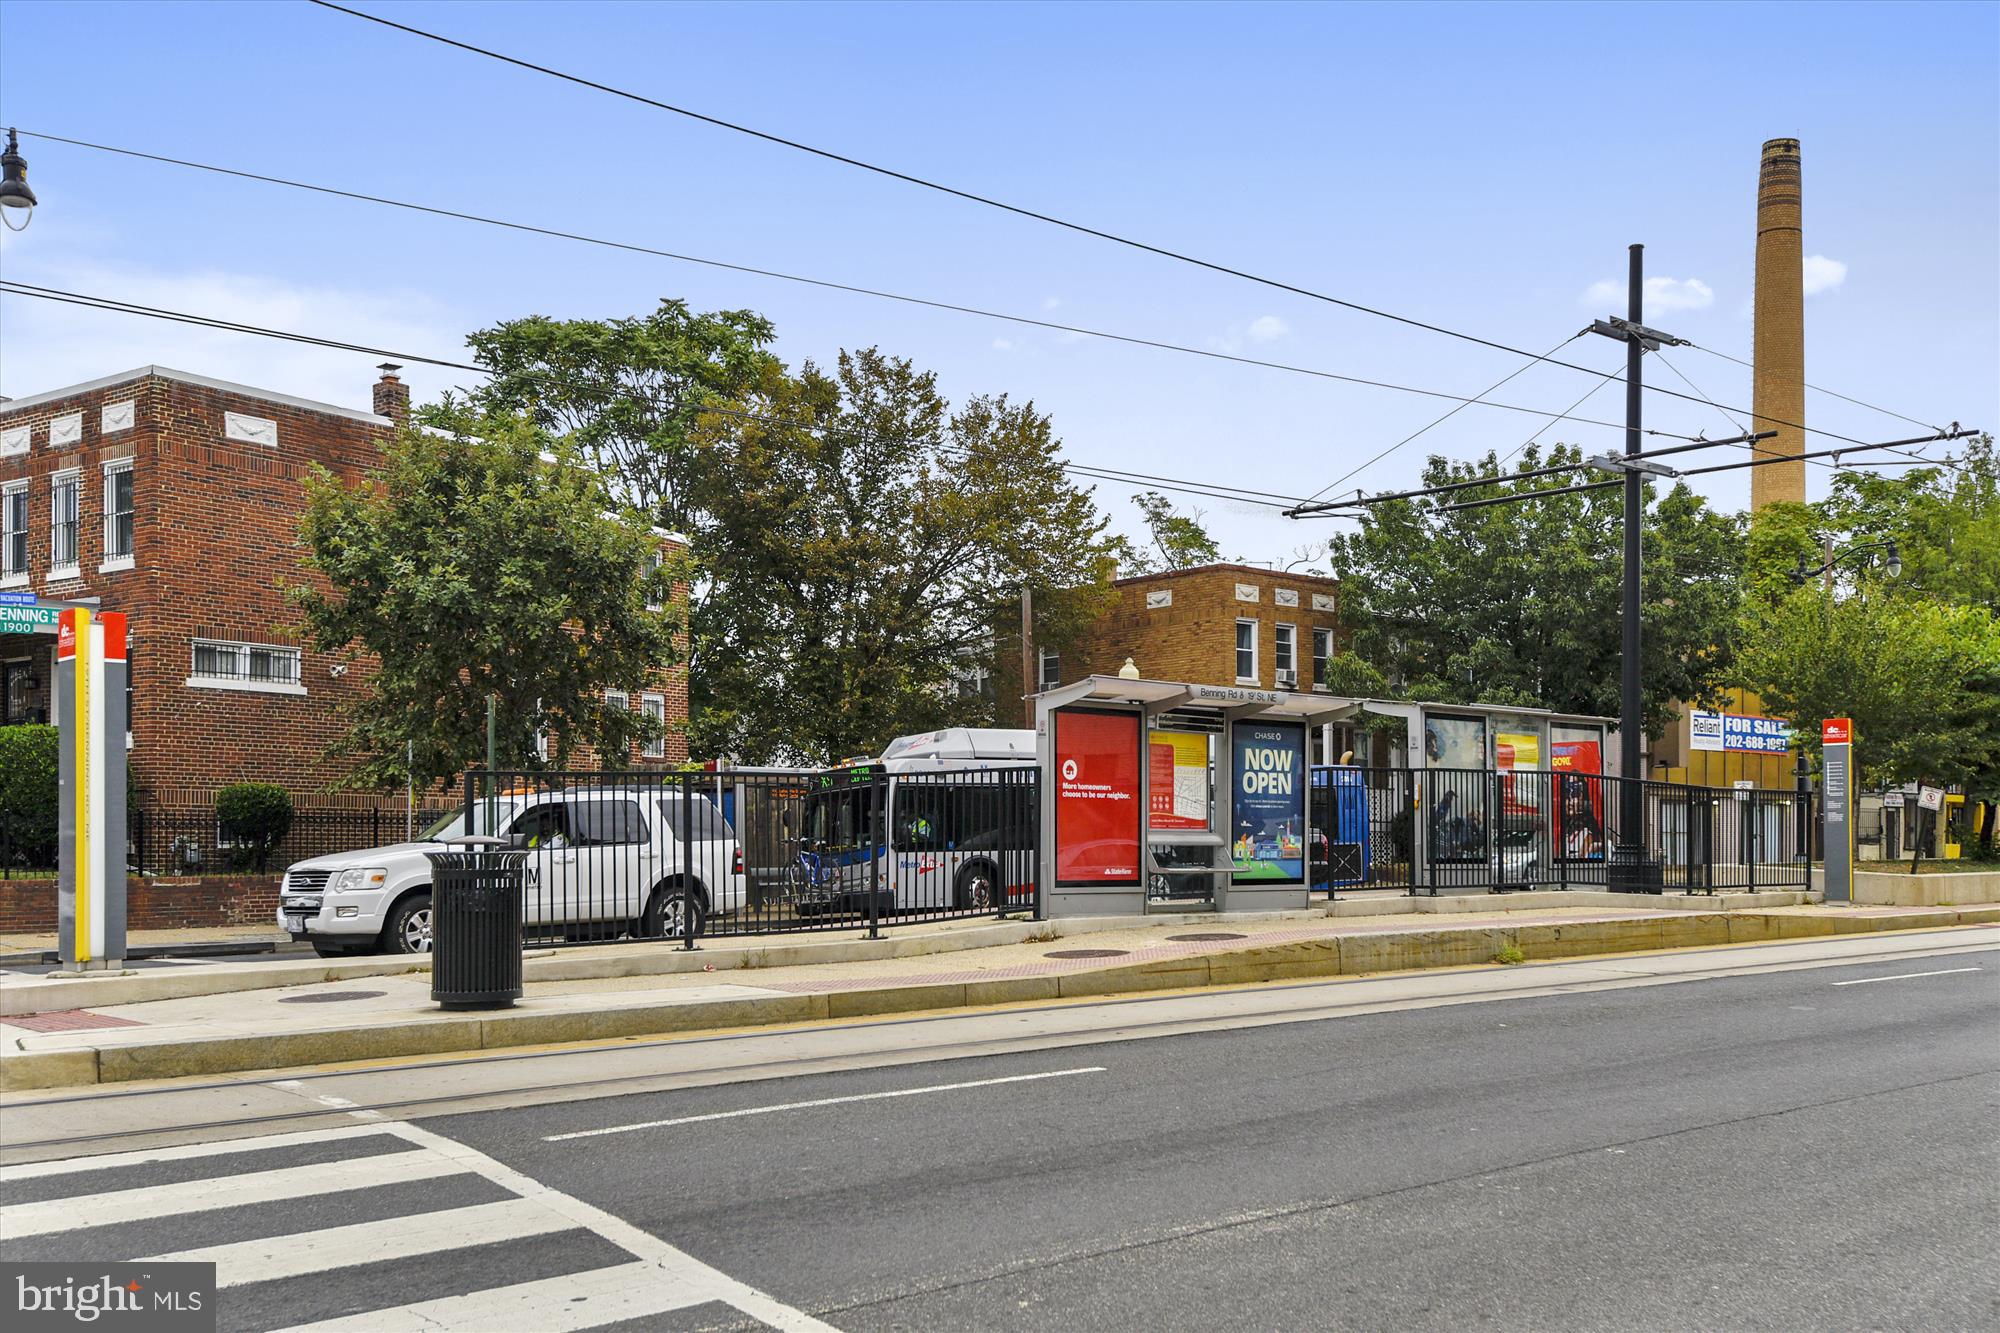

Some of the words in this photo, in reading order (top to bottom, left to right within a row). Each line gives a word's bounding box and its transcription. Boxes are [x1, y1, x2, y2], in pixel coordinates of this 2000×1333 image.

[3, 622, 31, 633] 1900
[1200, 687, 1226, 700] Benning
[1228, 689, 1238, 699] Rd
[1267, 693, 1277, 703] NE
[1693, 718, 1721, 734] Reliant
[1725, 716, 1752, 734] FOR
[1254, 732, 1276, 740] CHASE
[1244, 747, 1293, 772] NOW
[1062, 782, 1077, 790] More
[1078, 782, 1112, 791] homeowners
[1242, 771, 1293, 795] OPEN
[1062, 790, 1081, 798] choose
[1089, 791, 1096, 799] be
